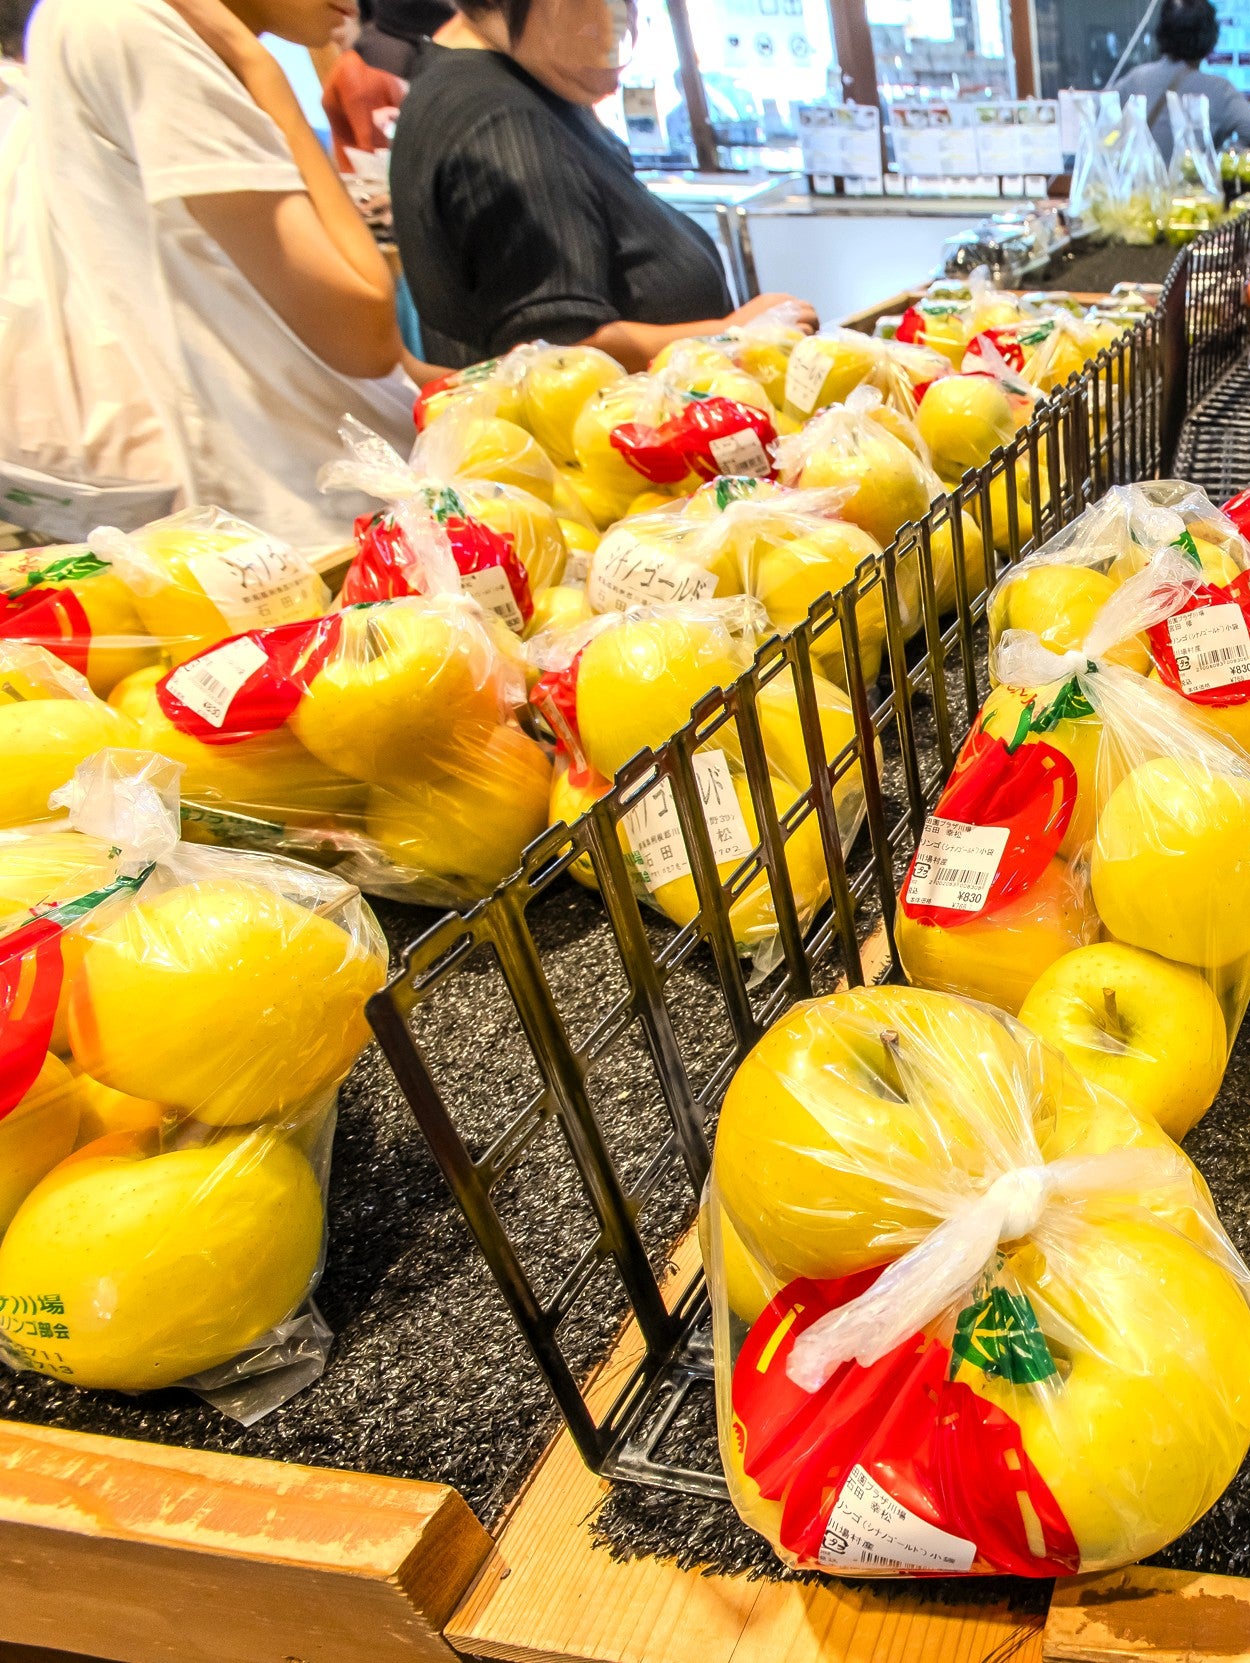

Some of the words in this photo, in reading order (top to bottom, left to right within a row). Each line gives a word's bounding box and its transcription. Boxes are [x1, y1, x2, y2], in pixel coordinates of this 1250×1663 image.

[924, 824, 940, 834] 石田
[957, 891, 982, 904] ¥830
[846, 1477, 864, 1501] 石田
[870, 1501, 892, 1523] 幸松
[851, 1467, 907, 1521] 田園プラザ川場
[828, 1518, 875, 1551] 川場村産
